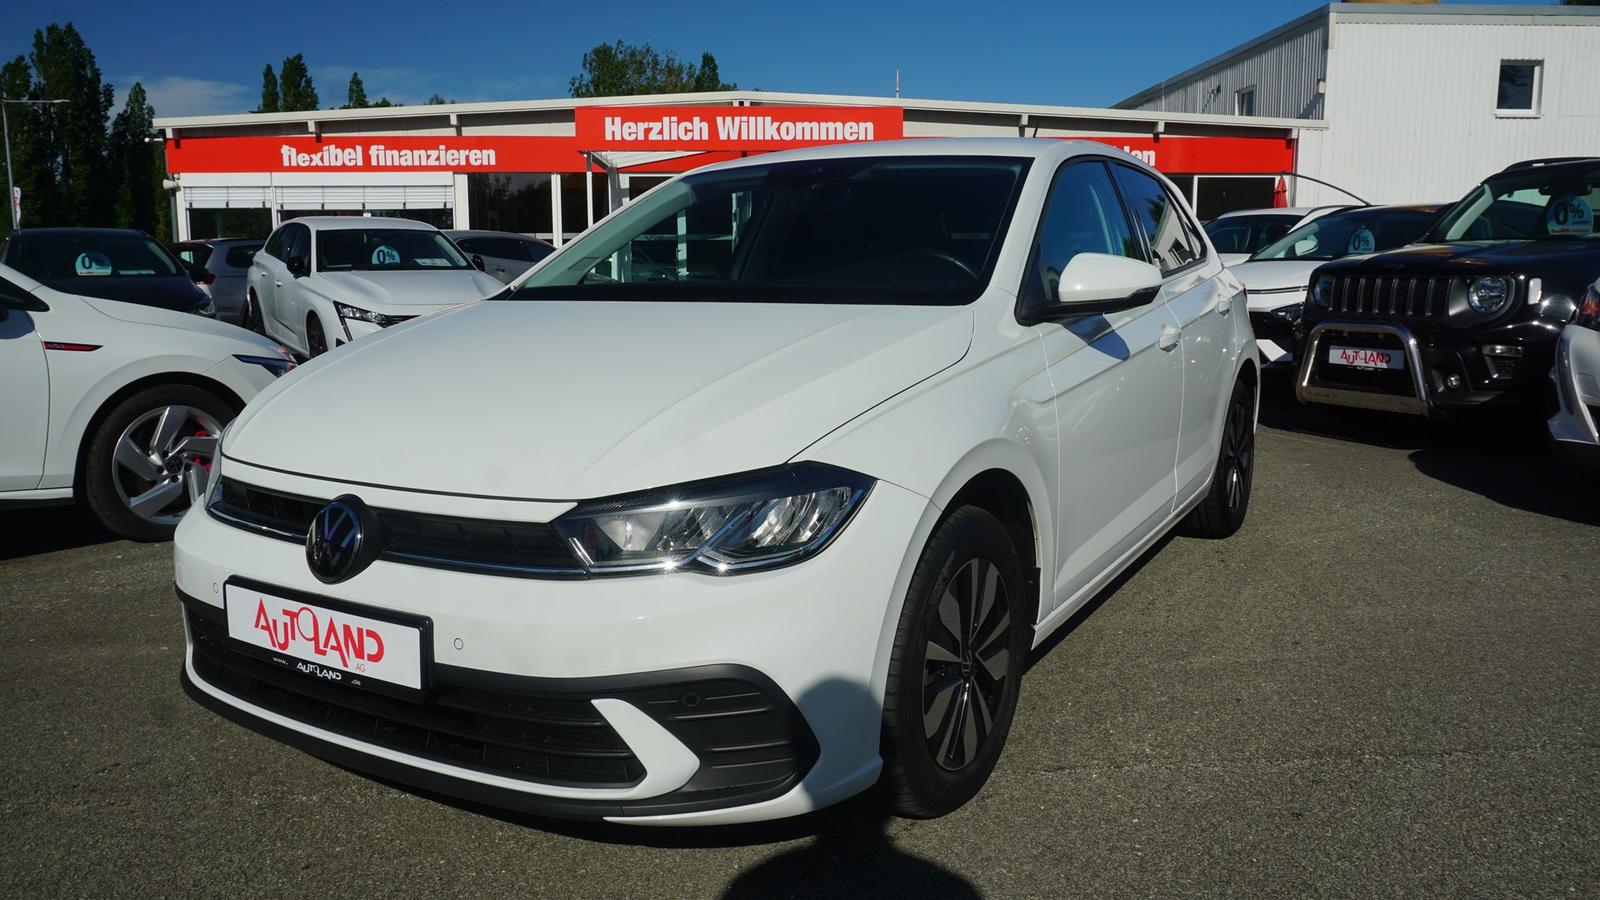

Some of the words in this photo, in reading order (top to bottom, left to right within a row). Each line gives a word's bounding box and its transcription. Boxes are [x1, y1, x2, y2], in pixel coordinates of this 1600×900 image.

[604, 115, 709, 142] Herzlich
[716, 115, 875, 142] Willkommen
[280, 143, 363, 168] flexibel
[368, 144, 497, 168] finanzieren
[1554, 203, 1585, 225] 0%
[376, 249, 396, 264] 0%
[254, 598, 385, 669] AUTOLAND
